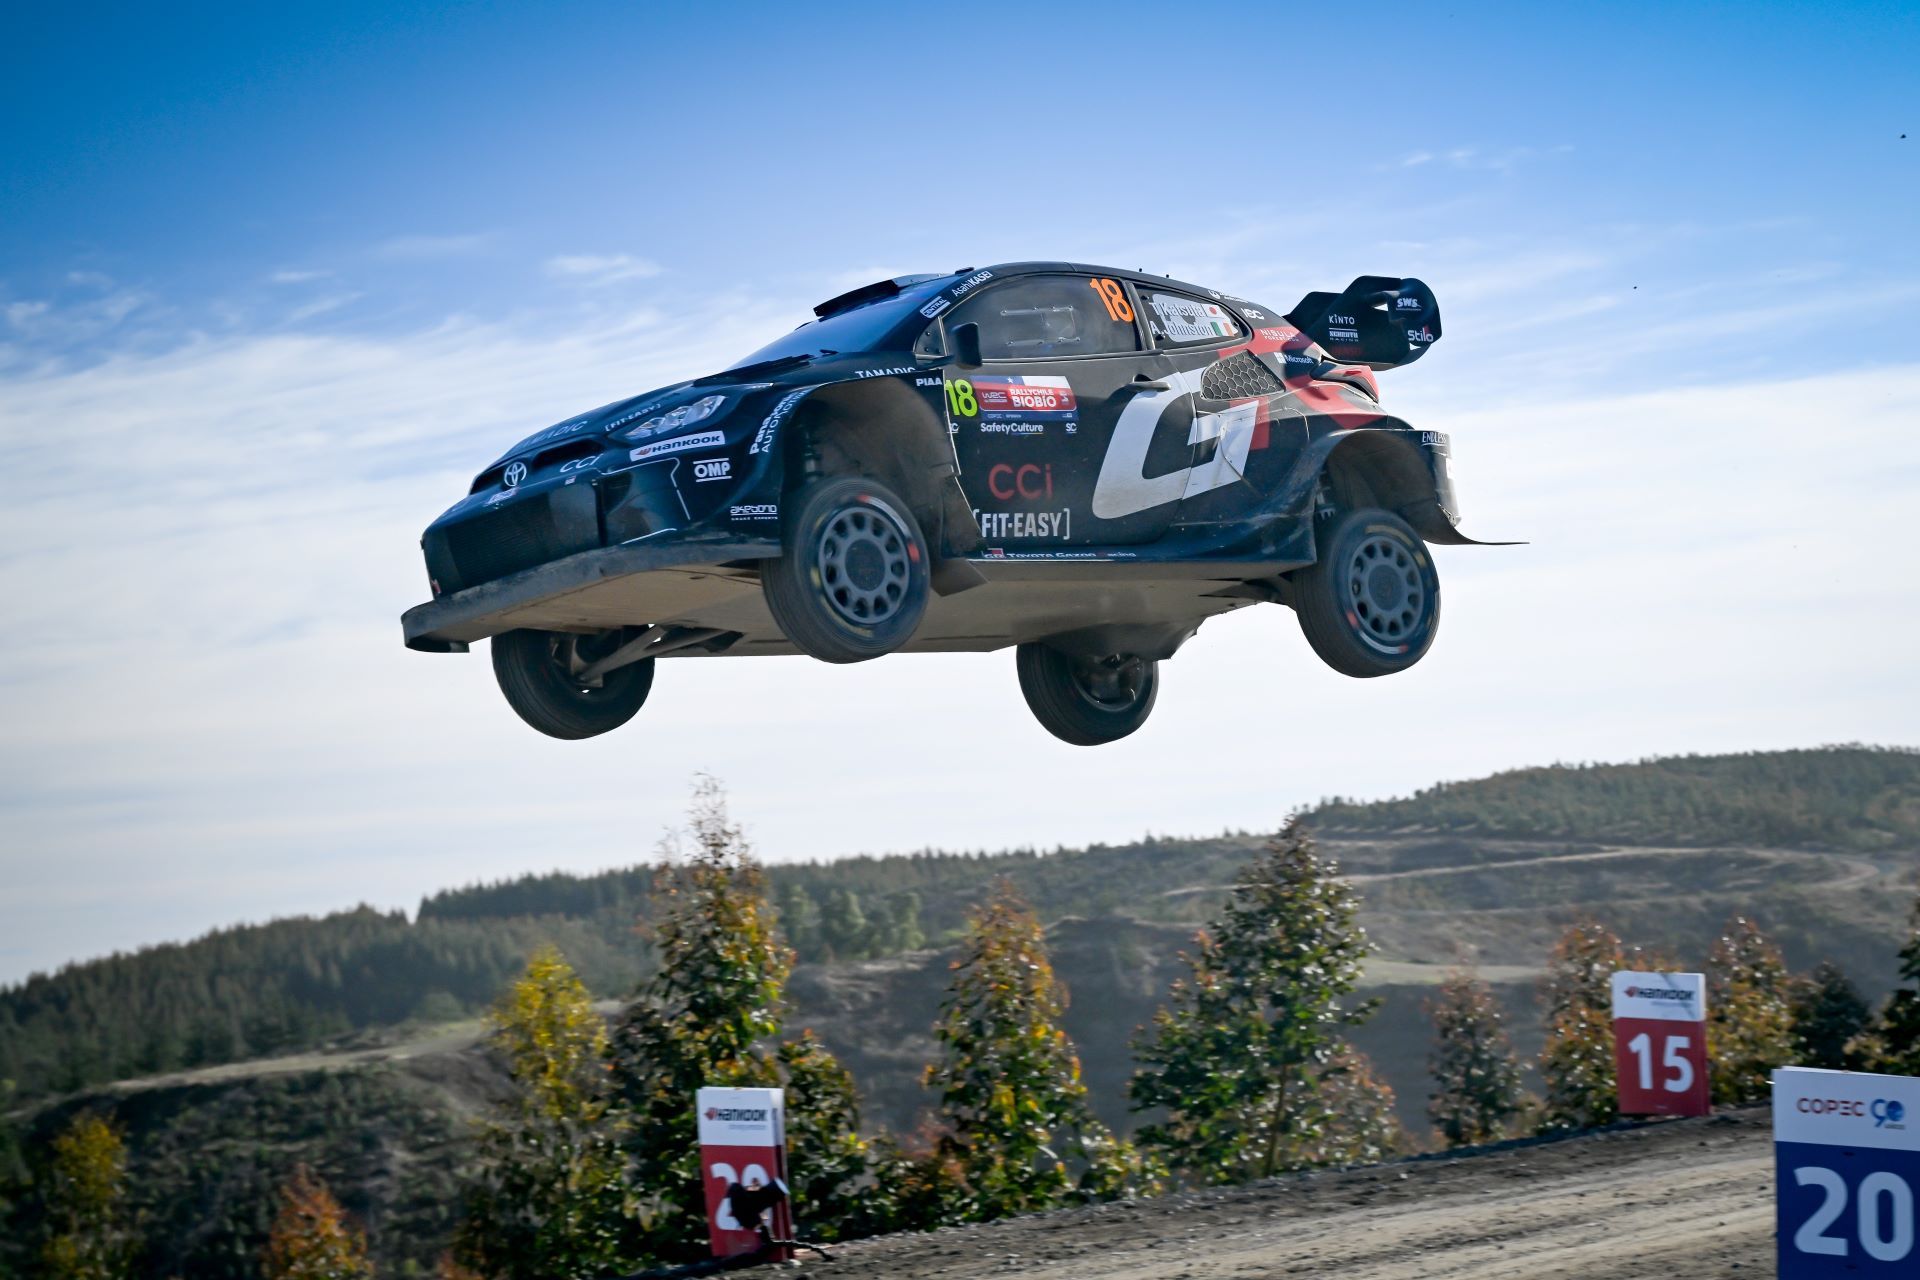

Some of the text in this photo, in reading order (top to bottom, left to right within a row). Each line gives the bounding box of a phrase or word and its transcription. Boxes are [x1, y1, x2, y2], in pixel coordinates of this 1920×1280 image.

[1090, 277, 1134, 322] 18
[1407, 327, 1434, 342] Stilo
[916, 378, 943, 387] PIAA
[944, 379, 978, 417] 18
[1066, 423, 1077, 433] SC
[694, 461, 731, 478] OMP
[1628, 1032, 1694, 1093] 15
[1797, 1097, 1864, 1117] COPEC
[1793, 1166, 1914, 1262] 20
